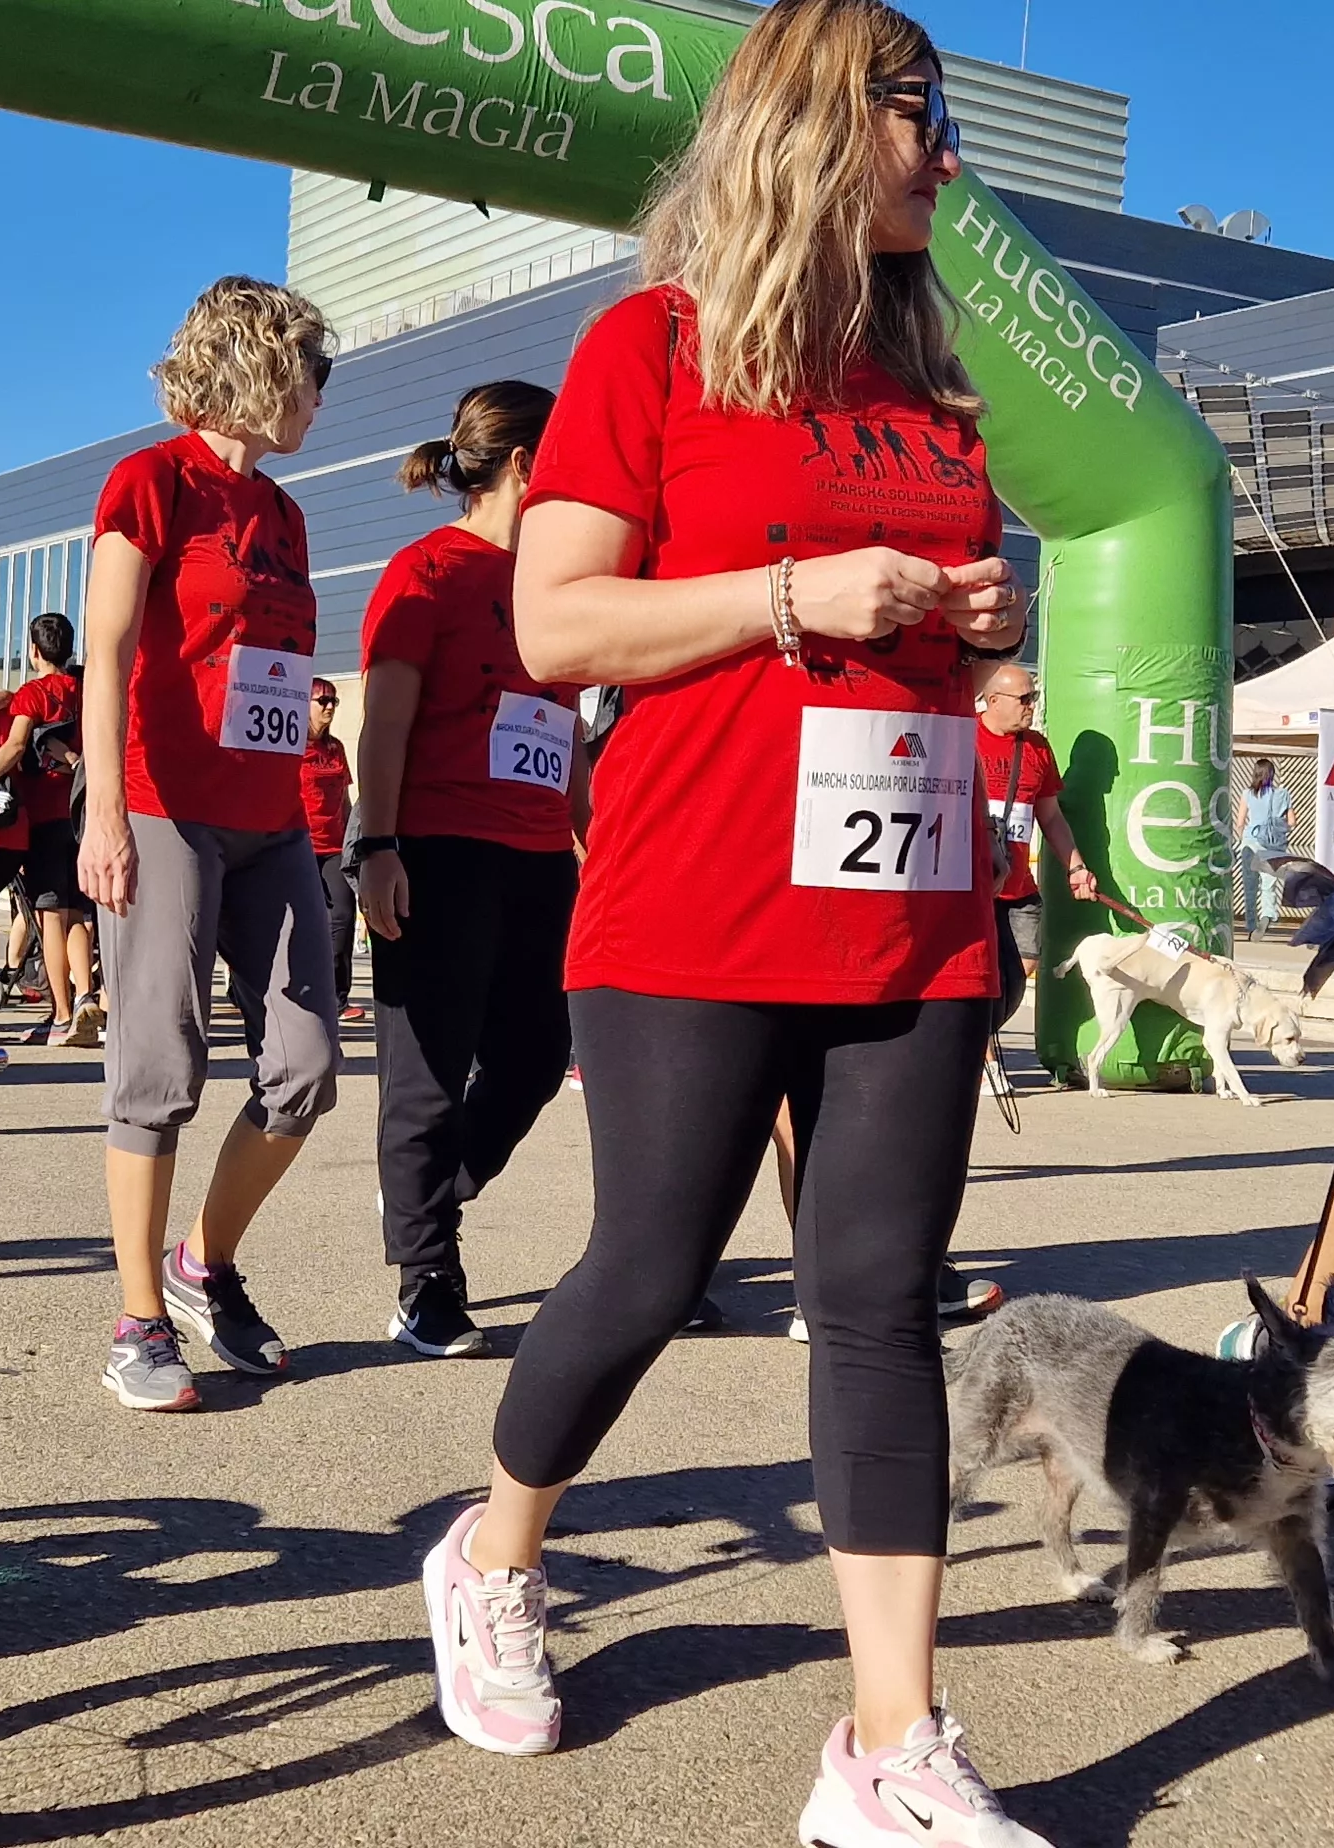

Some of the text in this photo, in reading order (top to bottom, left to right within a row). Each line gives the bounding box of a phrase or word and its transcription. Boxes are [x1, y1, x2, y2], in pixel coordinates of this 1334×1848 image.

[259, 49, 346, 115] La
[951, 194, 1144, 412] Huesca
[963, 277, 1004, 326] La
[828, 482, 886, 499] MARCHA
[887, 488, 957, 506] SOLIDARIA
[245, 704, 299, 747] 396
[512, 742, 562, 784] 209
[811, 771, 847, 789] MARCHA
[849, 773, 892, 792] SOLIDARIA
[893, 776, 907, 793] POR
[908, 777, 917, 793] LA
[839, 809, 943, 876] 271
[1129, 885, 1165, 908] La
